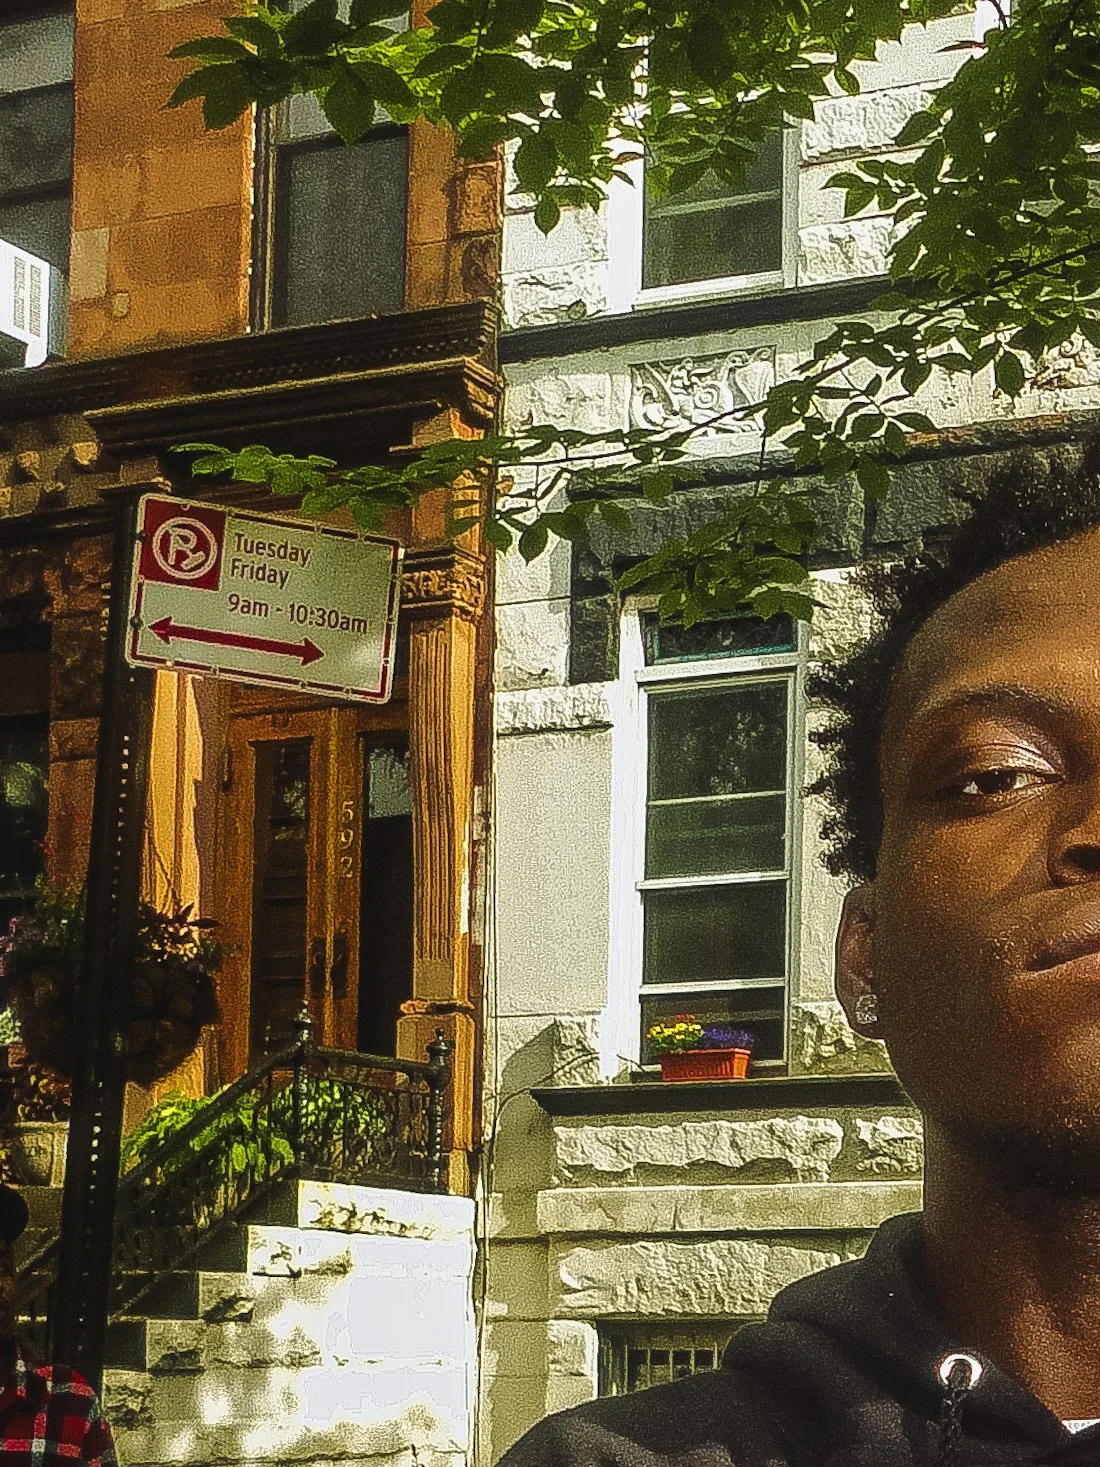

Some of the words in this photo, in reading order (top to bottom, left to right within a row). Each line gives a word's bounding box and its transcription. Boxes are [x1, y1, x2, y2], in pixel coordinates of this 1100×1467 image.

[234, 532, 312, 567] Tuesday
[230, 558, 289, 589] Friday
[228, 594, 269, 617] 9am
[289, 603, 368, 634] 10:30am
[340, 800, 354, 878] 592
